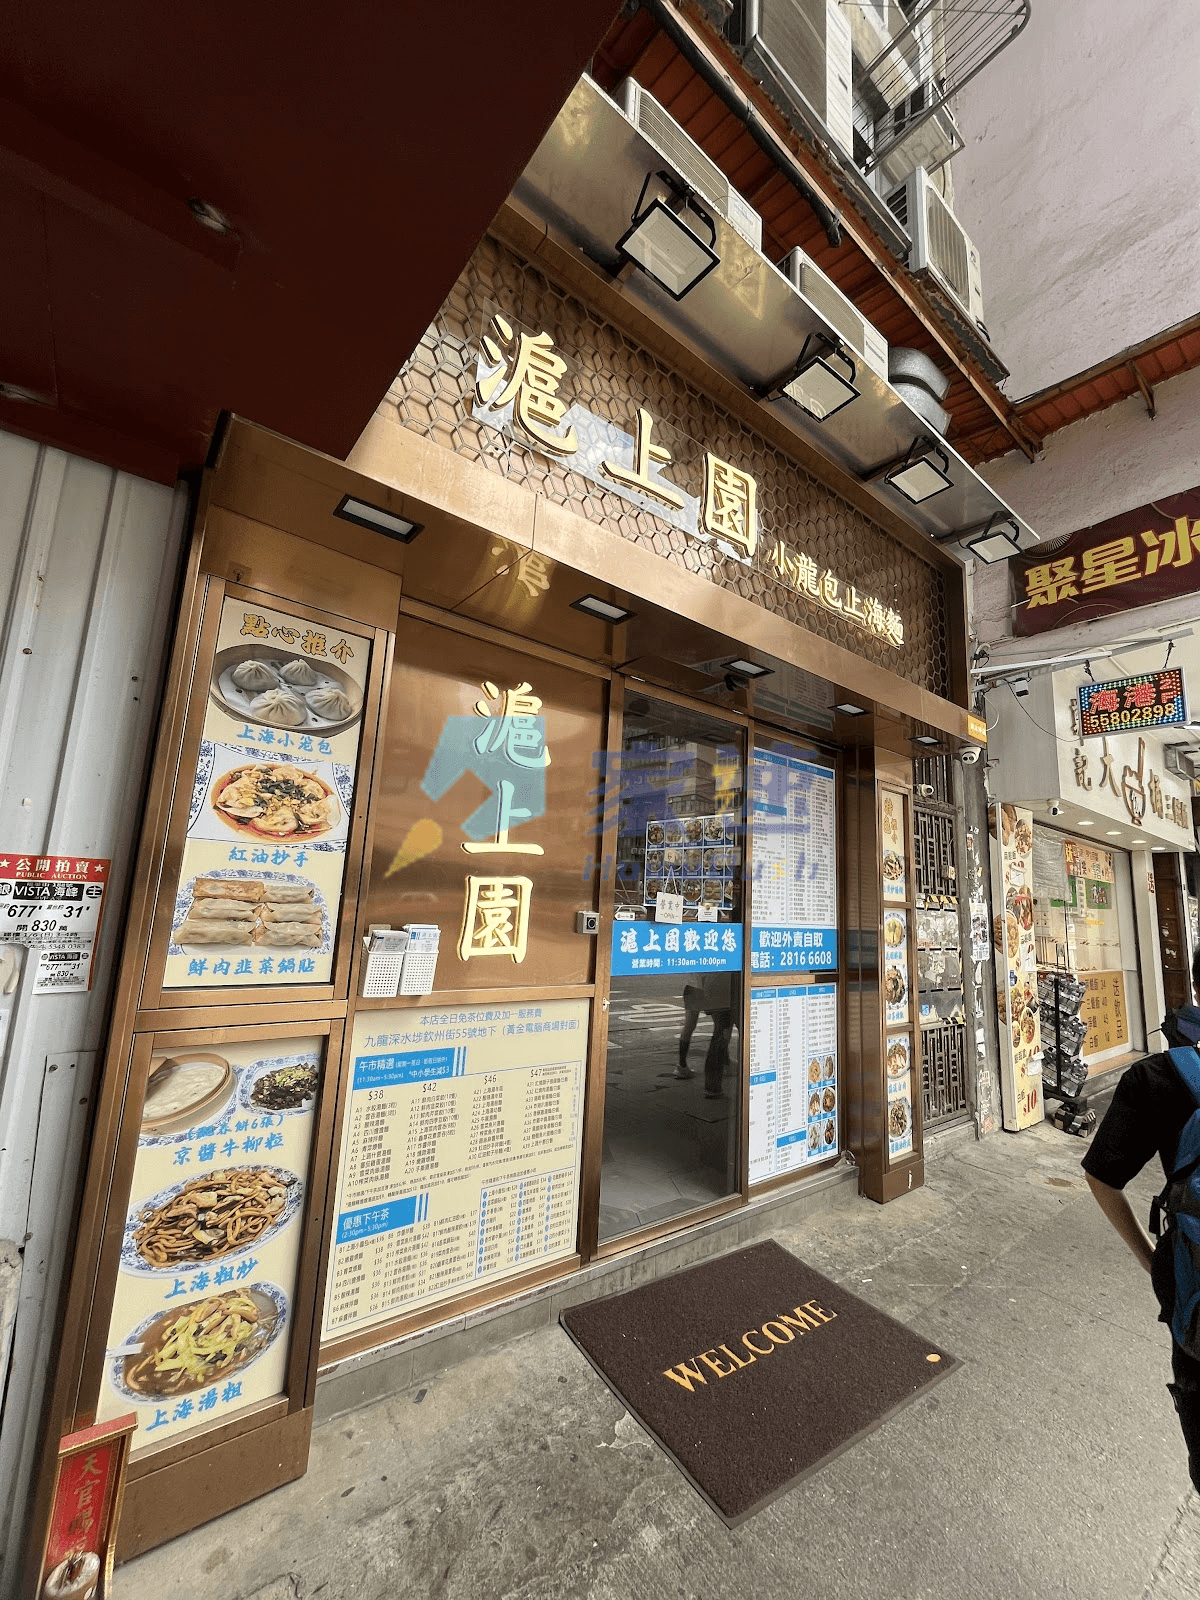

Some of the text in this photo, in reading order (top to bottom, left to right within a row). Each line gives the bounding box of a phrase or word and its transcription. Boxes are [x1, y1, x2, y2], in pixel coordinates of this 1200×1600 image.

[475, 314, 757, 557] 滬上園
[1025, 516, 1200, 609] 聚星冰
[240, 613, 355, 665] 點心推介
[1090, 703, 1175, 728] 55802898
[457, 681, 551, 964] 滬上園
[16, 858, 90, 873] 公開拍賣
[228, 847, 309, 868] 紅油抄手
[51, 872, 88, 880] AUCTION
[15, 886, 50, 896] VISTA
[53, 887, 78, 897] 海峰
[31, 920, 57, 931] 830
[620, 928, 738, 953] 滬上園歡迎您
[759, 930, 824, 949] 歡迎外賣自取
[187, 957, 316, 976] 鮮肉韭菜鍋貼
[666, 957, 728, 968] 11:30am-10:00pm
[780, 950, 806, 967] 2816
[808, 950, 832, 966] 6608
[359, 1058, 395, 1073] 午市精選
[368, 1090, 384, 1100] $38
[423, 1083, 437, 1092] $42
[173, 1132, 283, 1166] 京醬牛柳粒
[343, 1208, 390, 1230] 優惠下午茶
[164, 1257, 258, 1299] 上海粗炒
[662, 1300, 838, 1392] WELCOME
[145, 1381, 243, 1431] 上海湯粗
